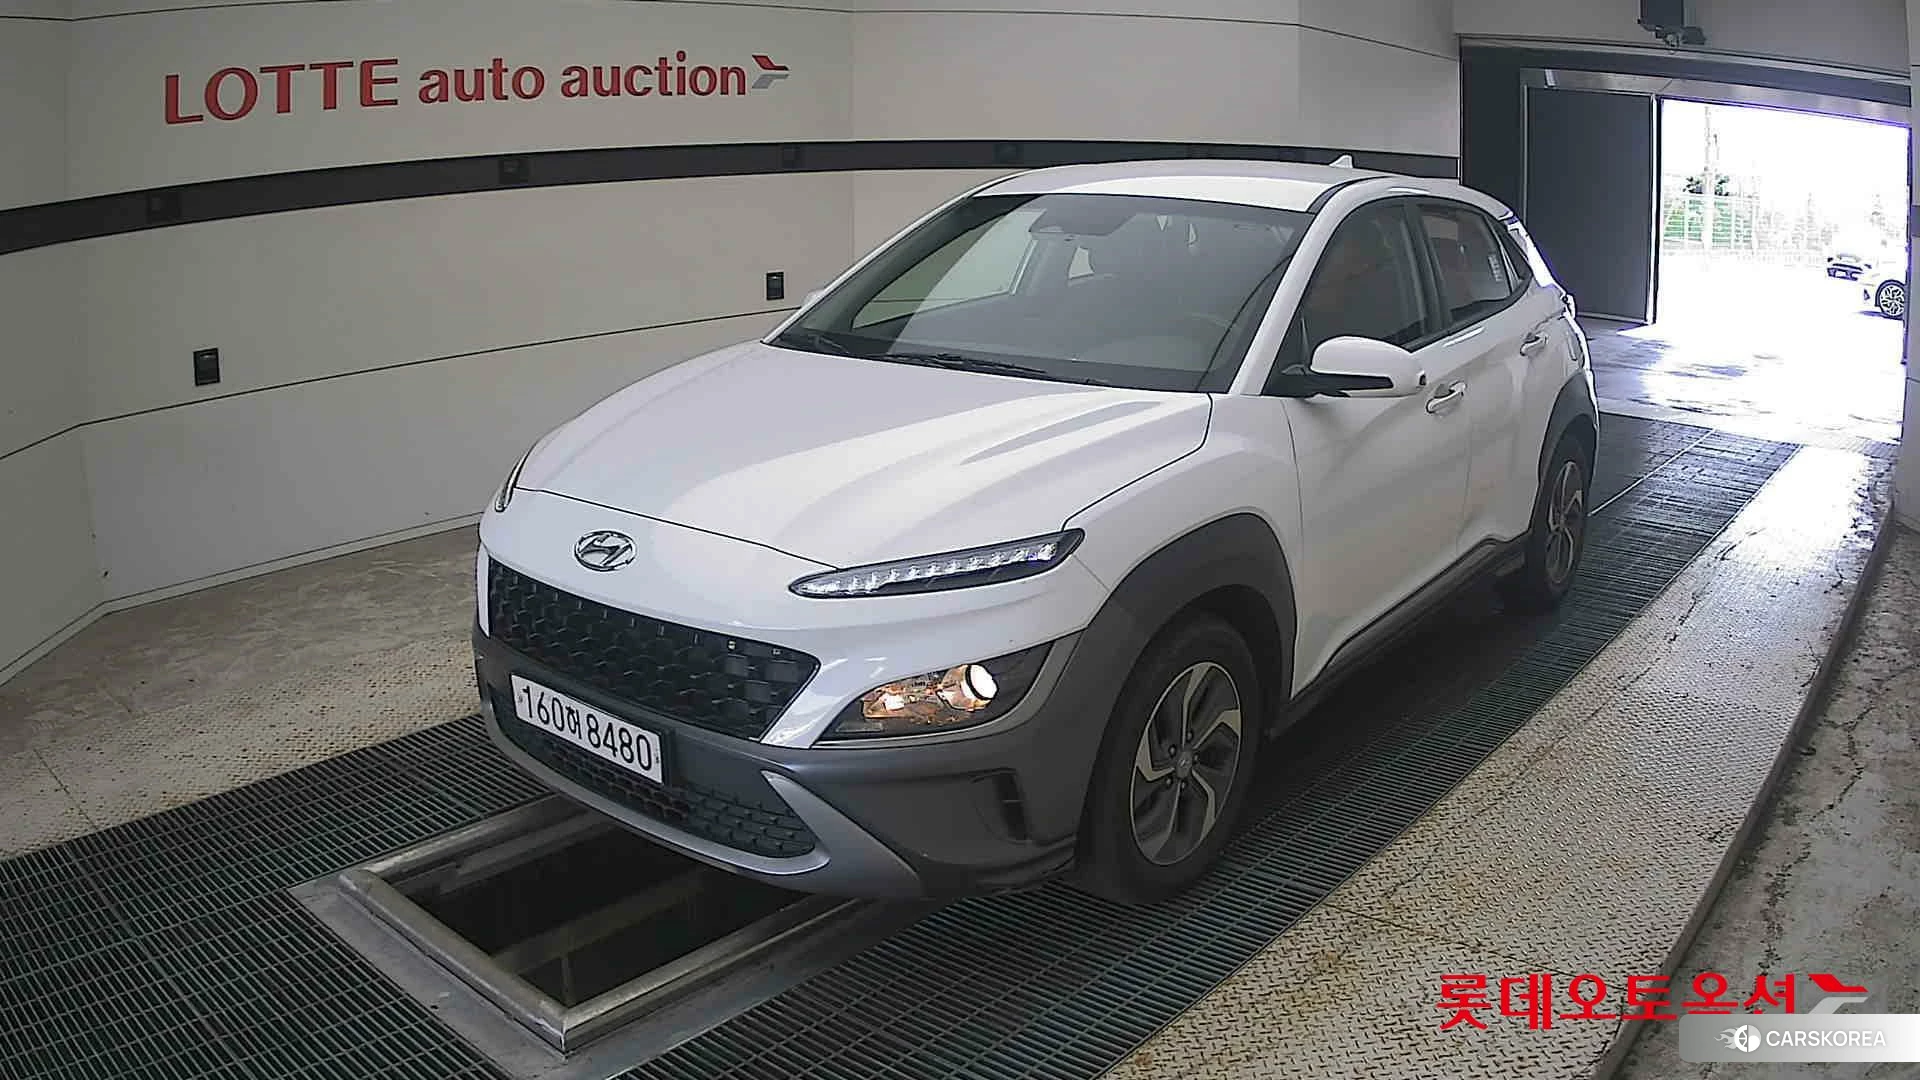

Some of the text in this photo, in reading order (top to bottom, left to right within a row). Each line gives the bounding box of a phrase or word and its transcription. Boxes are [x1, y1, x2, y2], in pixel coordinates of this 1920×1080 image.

[166, 51, 747, 124] LOTTE auto auction
